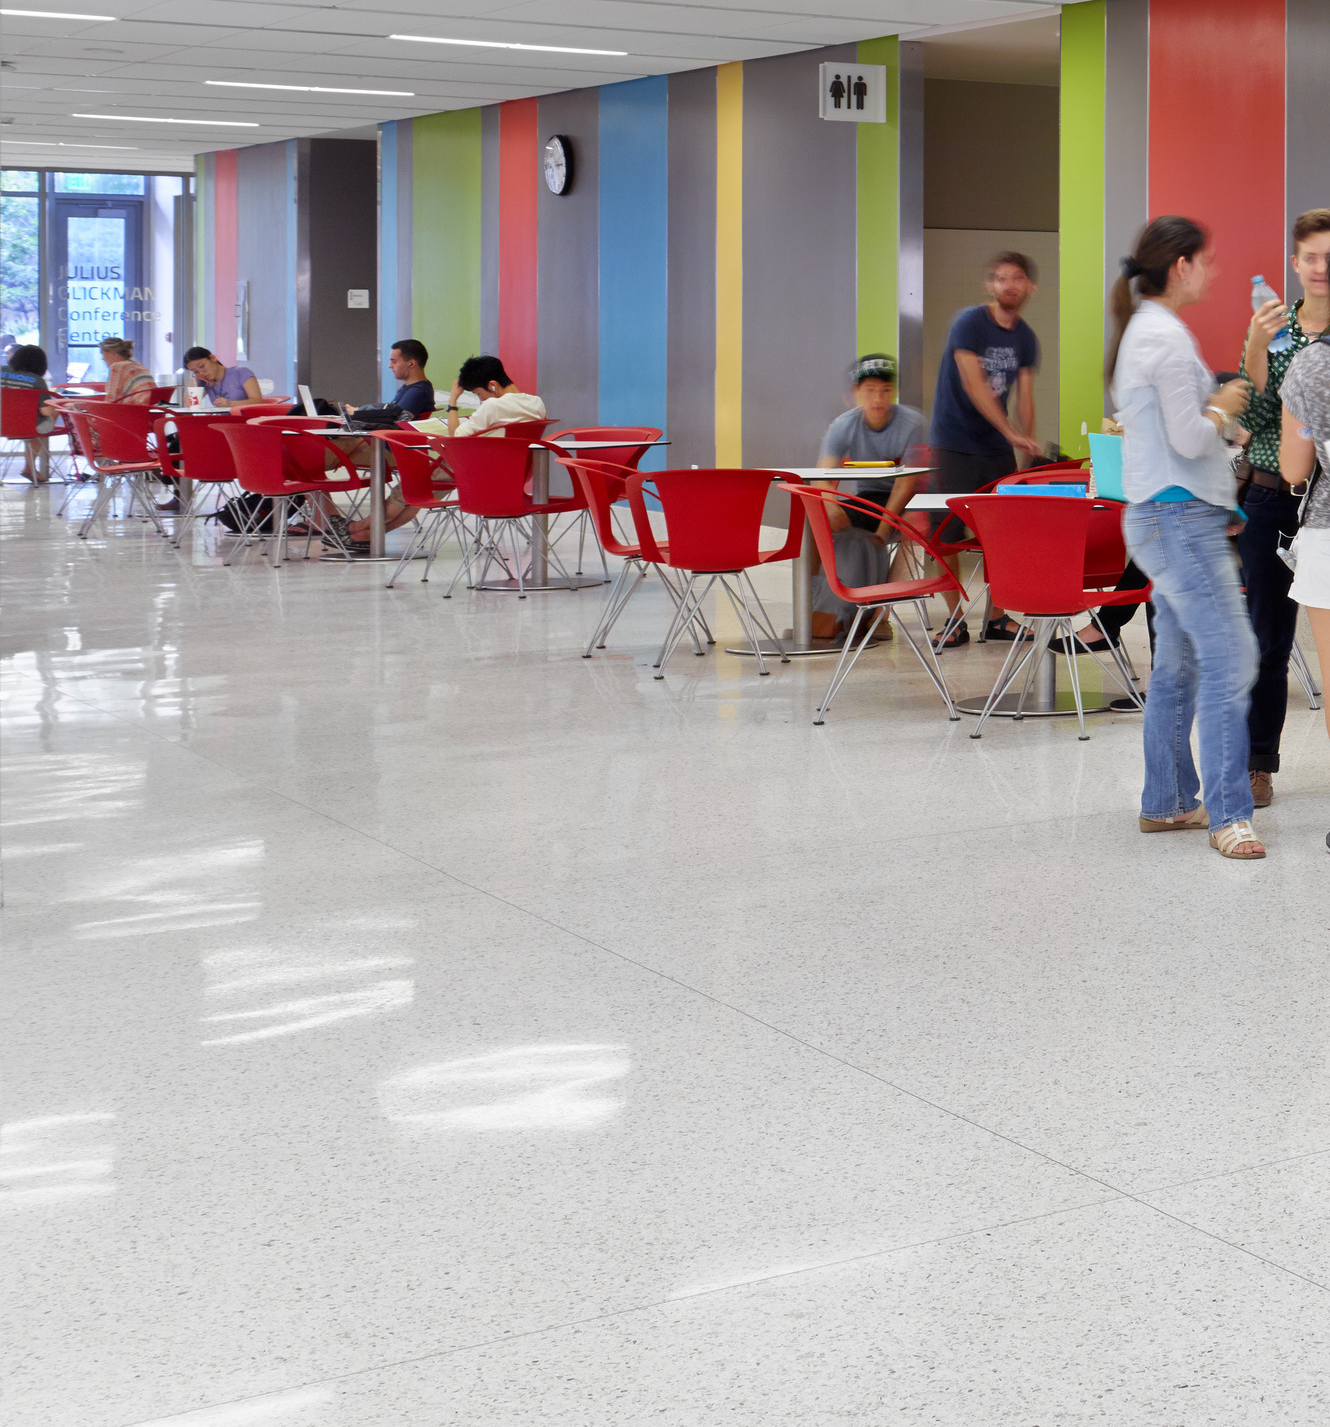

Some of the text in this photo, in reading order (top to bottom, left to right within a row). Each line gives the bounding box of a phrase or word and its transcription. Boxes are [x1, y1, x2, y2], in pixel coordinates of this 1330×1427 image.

[58, 265, 121, 280] JULIUS
[58, 286, 157, 300] GLICKMAN
[58, 307, 162, 321] Conference
